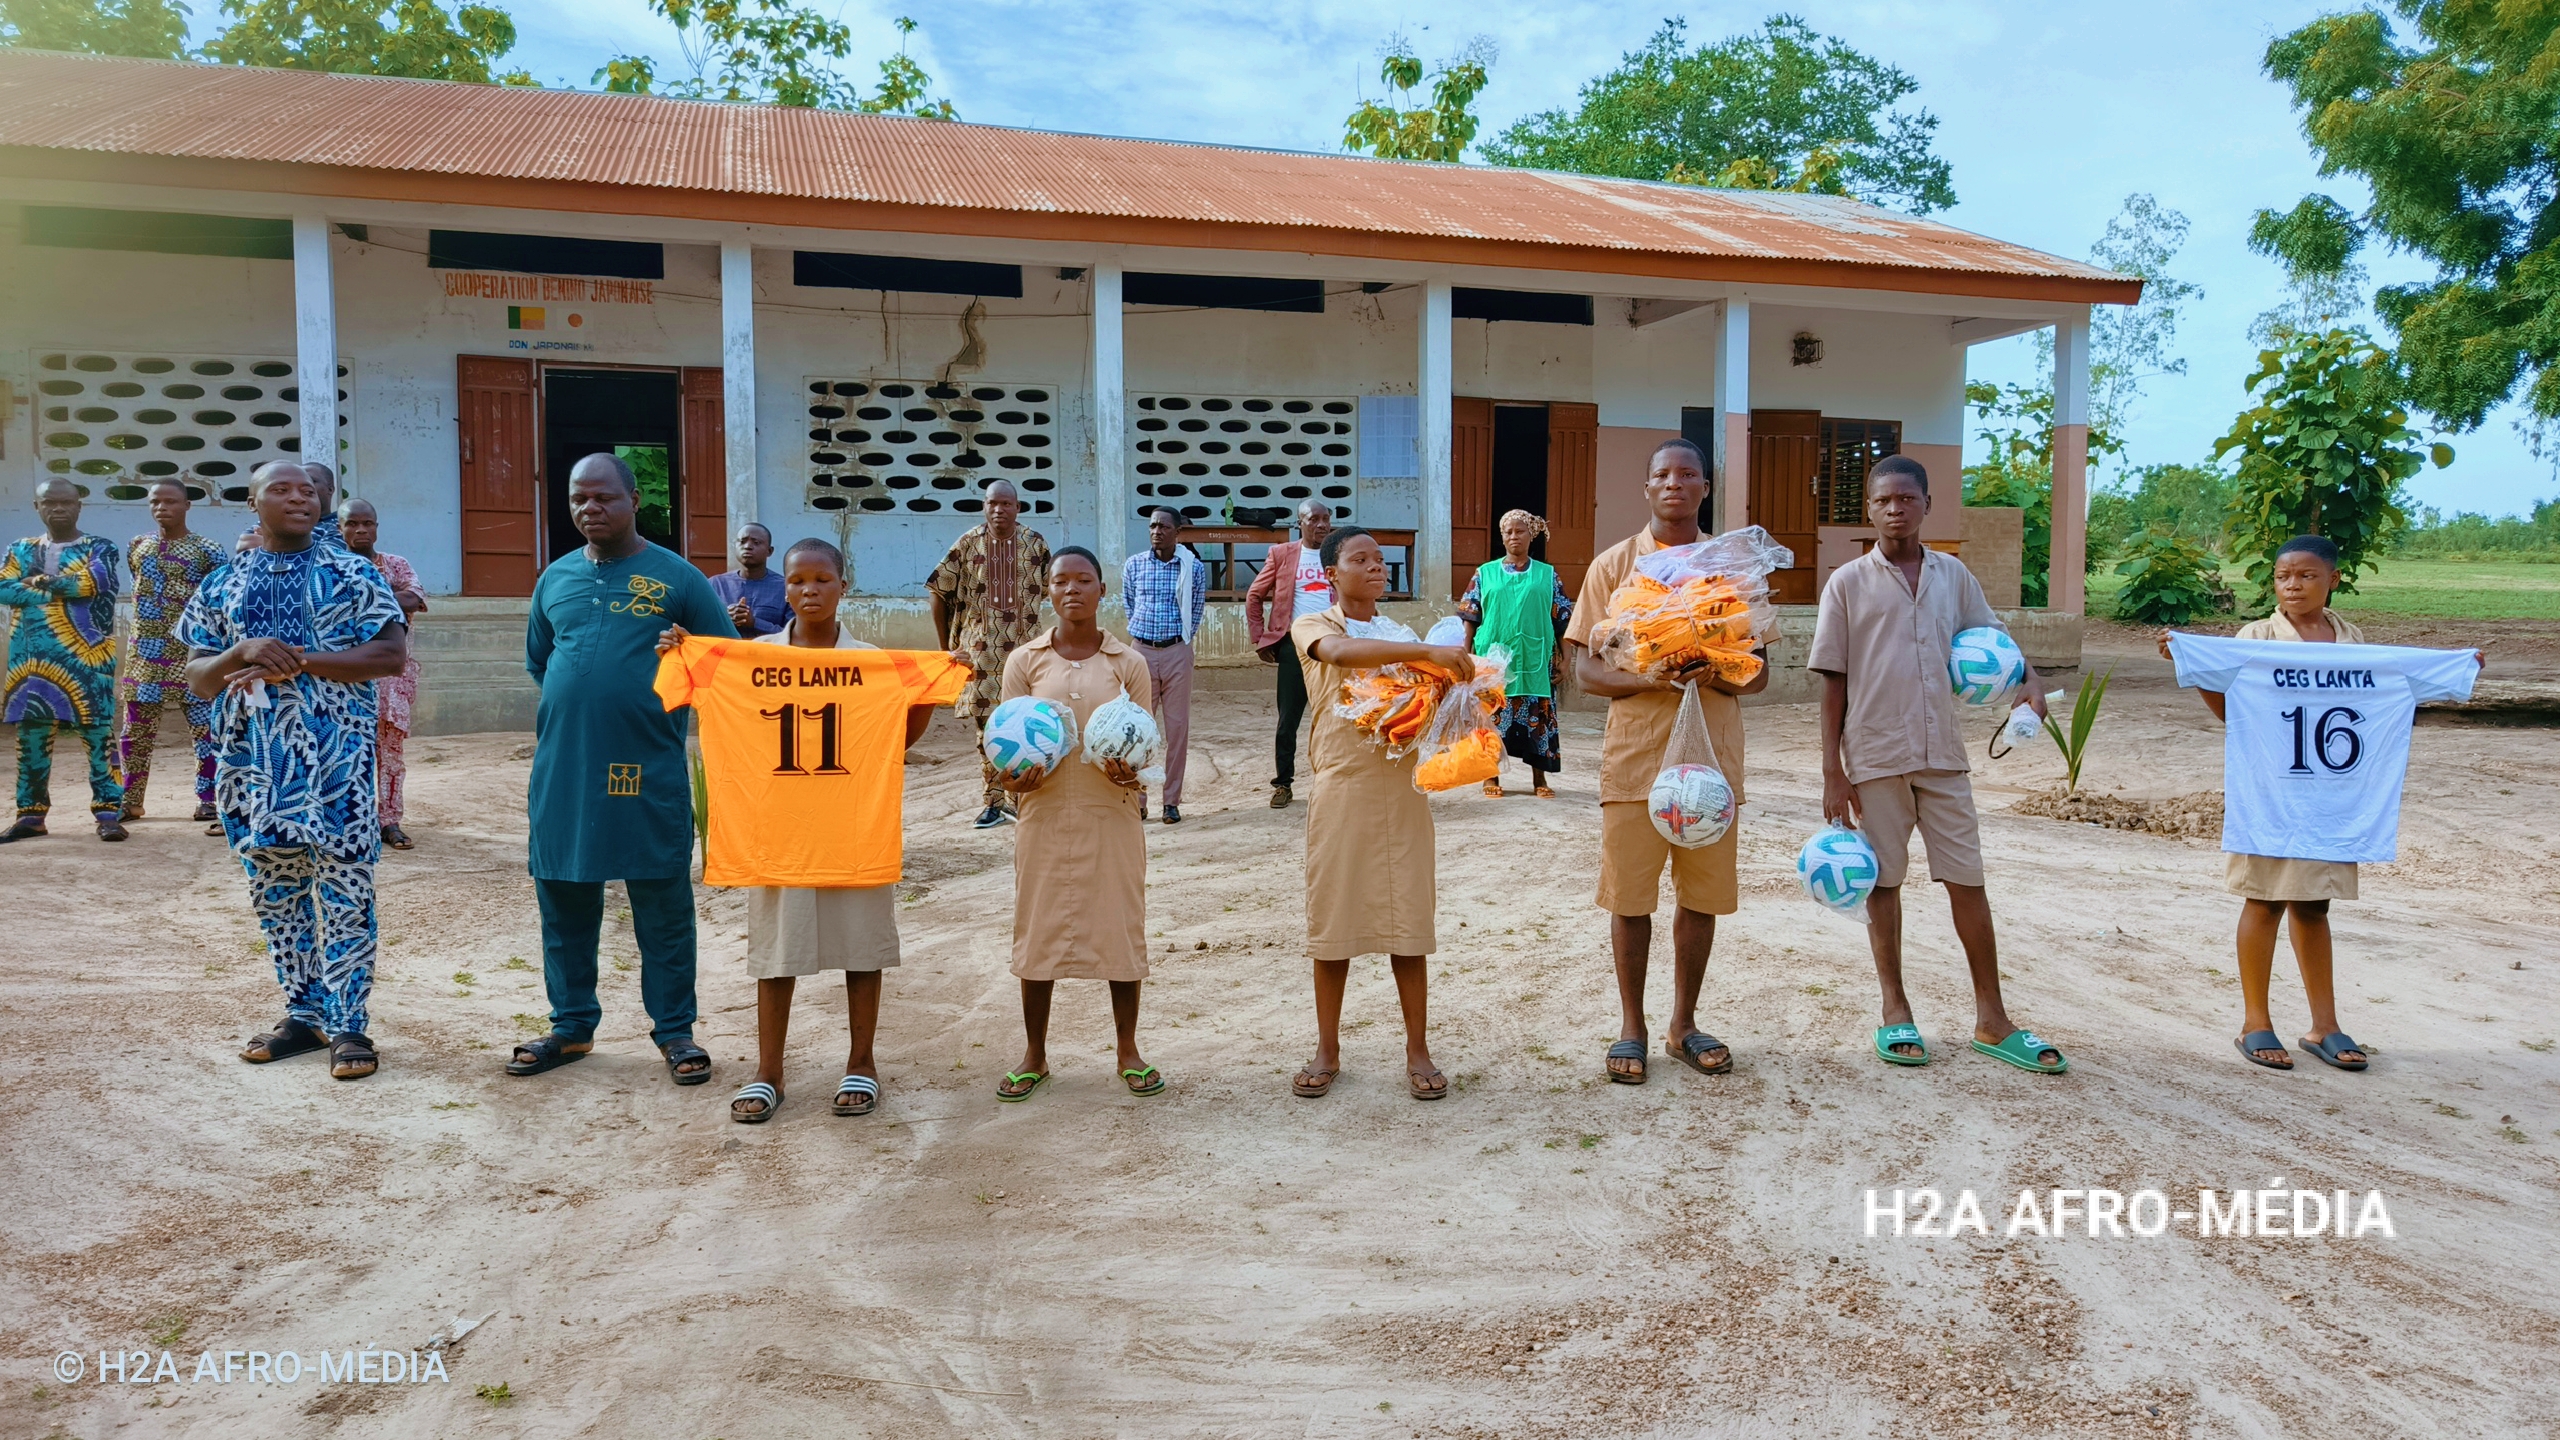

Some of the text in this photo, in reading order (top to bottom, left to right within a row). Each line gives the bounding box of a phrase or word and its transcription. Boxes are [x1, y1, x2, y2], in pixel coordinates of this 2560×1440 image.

[445, 273, 539, 300] COOPERATION
[591, 280, 653, 304] JAPONAISE
[508, 340, 528, 350] DON
[752, 667, 863, 687] CEG LANTA
[2273, 668, 2376, 688] CEG LANTA
[760, 702, 851, 776] 11
[2281, 705, 2366, 775] 16
